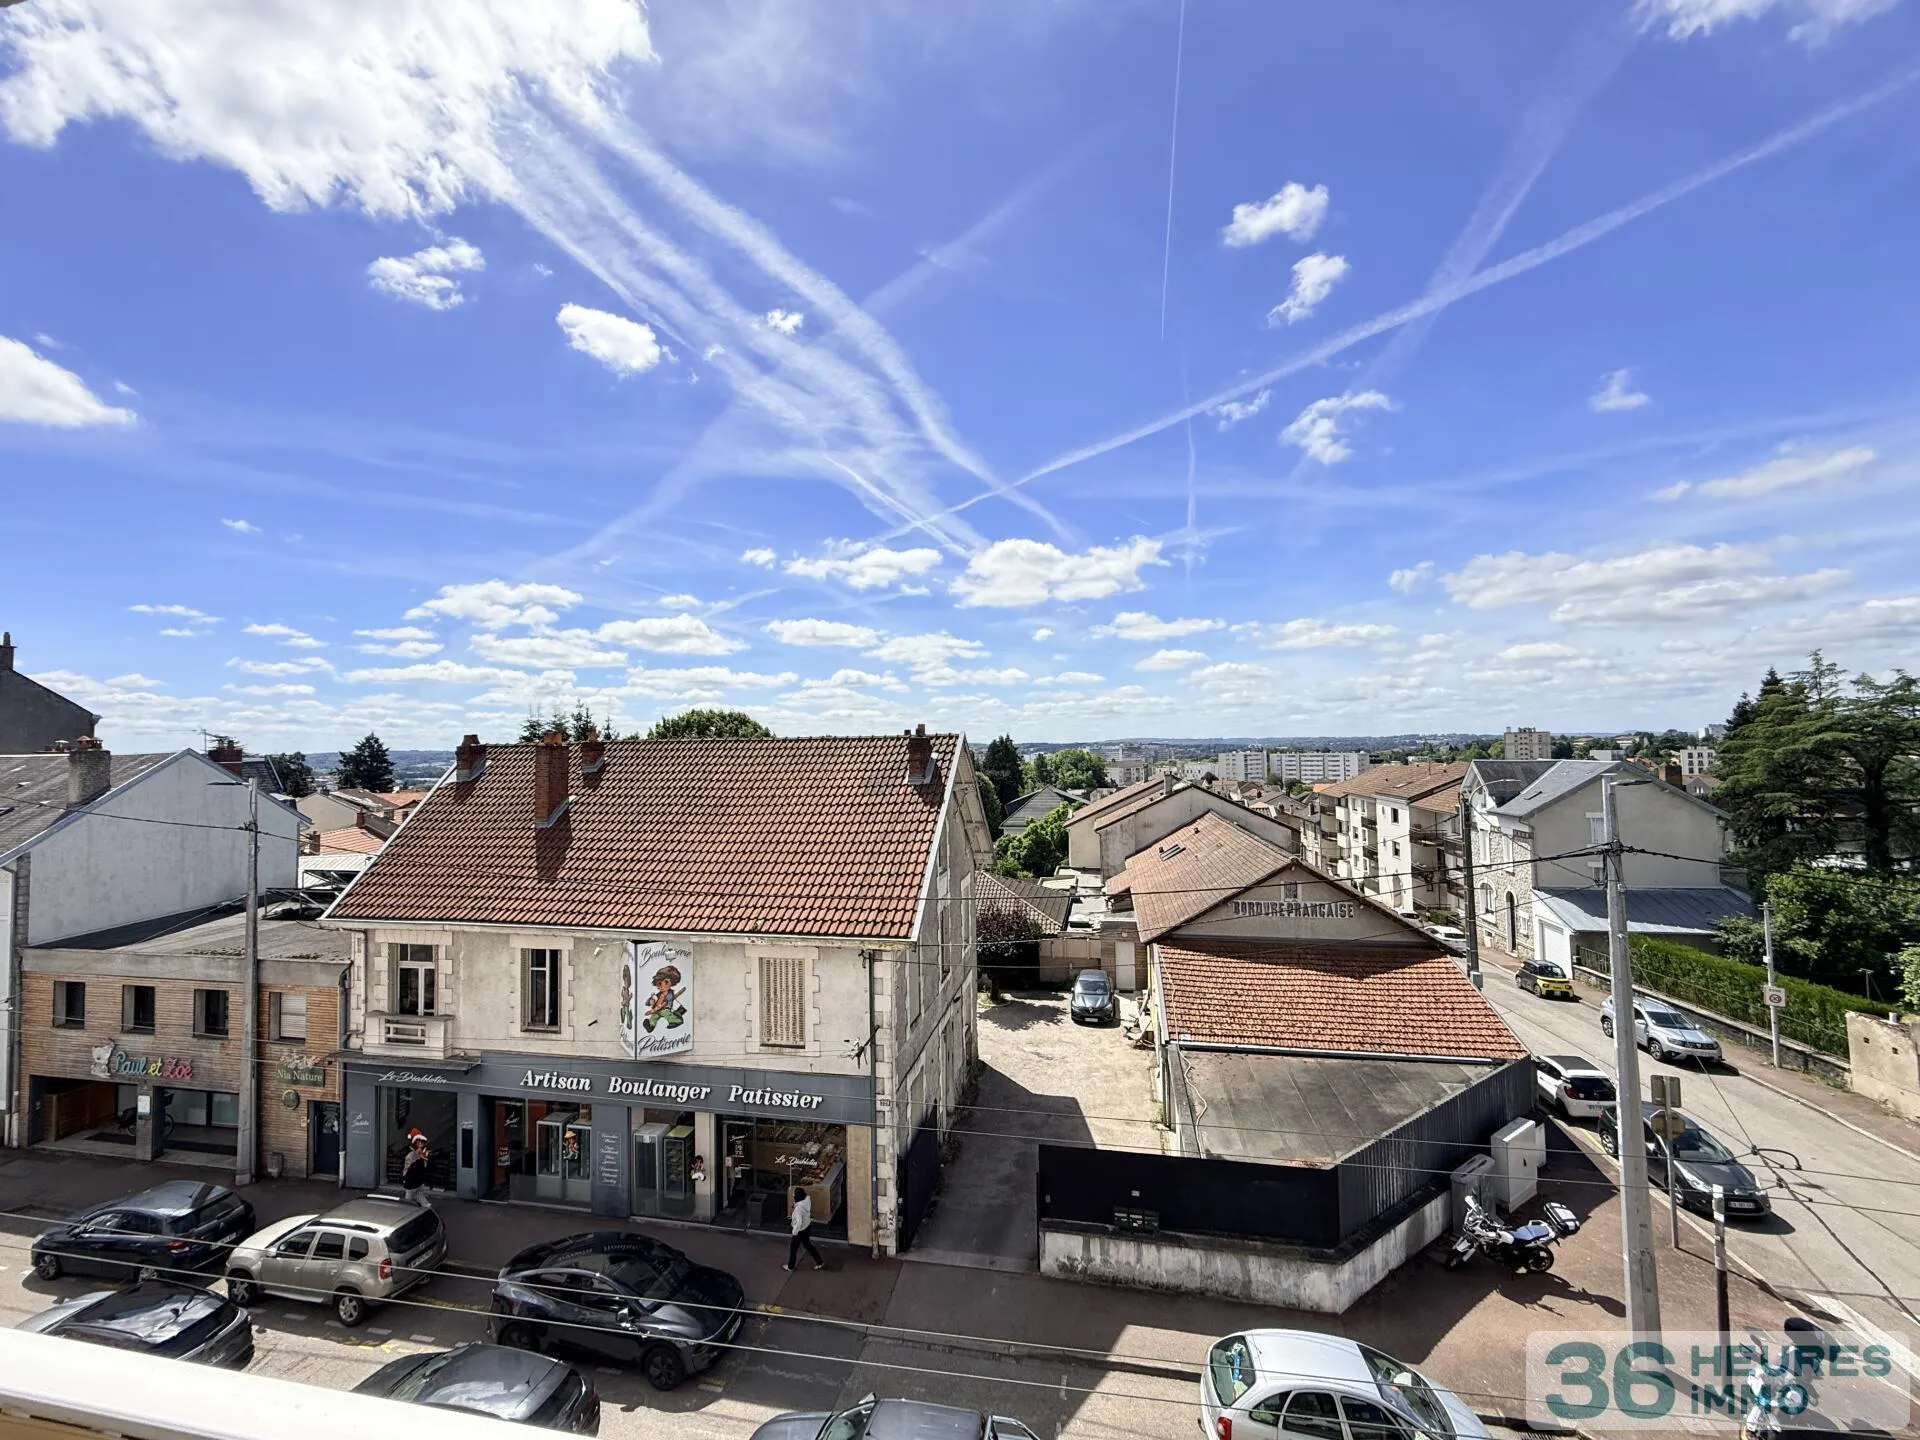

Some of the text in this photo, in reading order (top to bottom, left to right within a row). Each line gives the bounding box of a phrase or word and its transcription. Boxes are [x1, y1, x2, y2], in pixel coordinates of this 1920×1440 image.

[111, 1051, 147, 1075] Paul
[148, 1057, 163, 1077] et
[277, 1069, 323, 1082] Nia Nature
[520, 1069, 823, 1109] Artisan Boulanger Patissier
